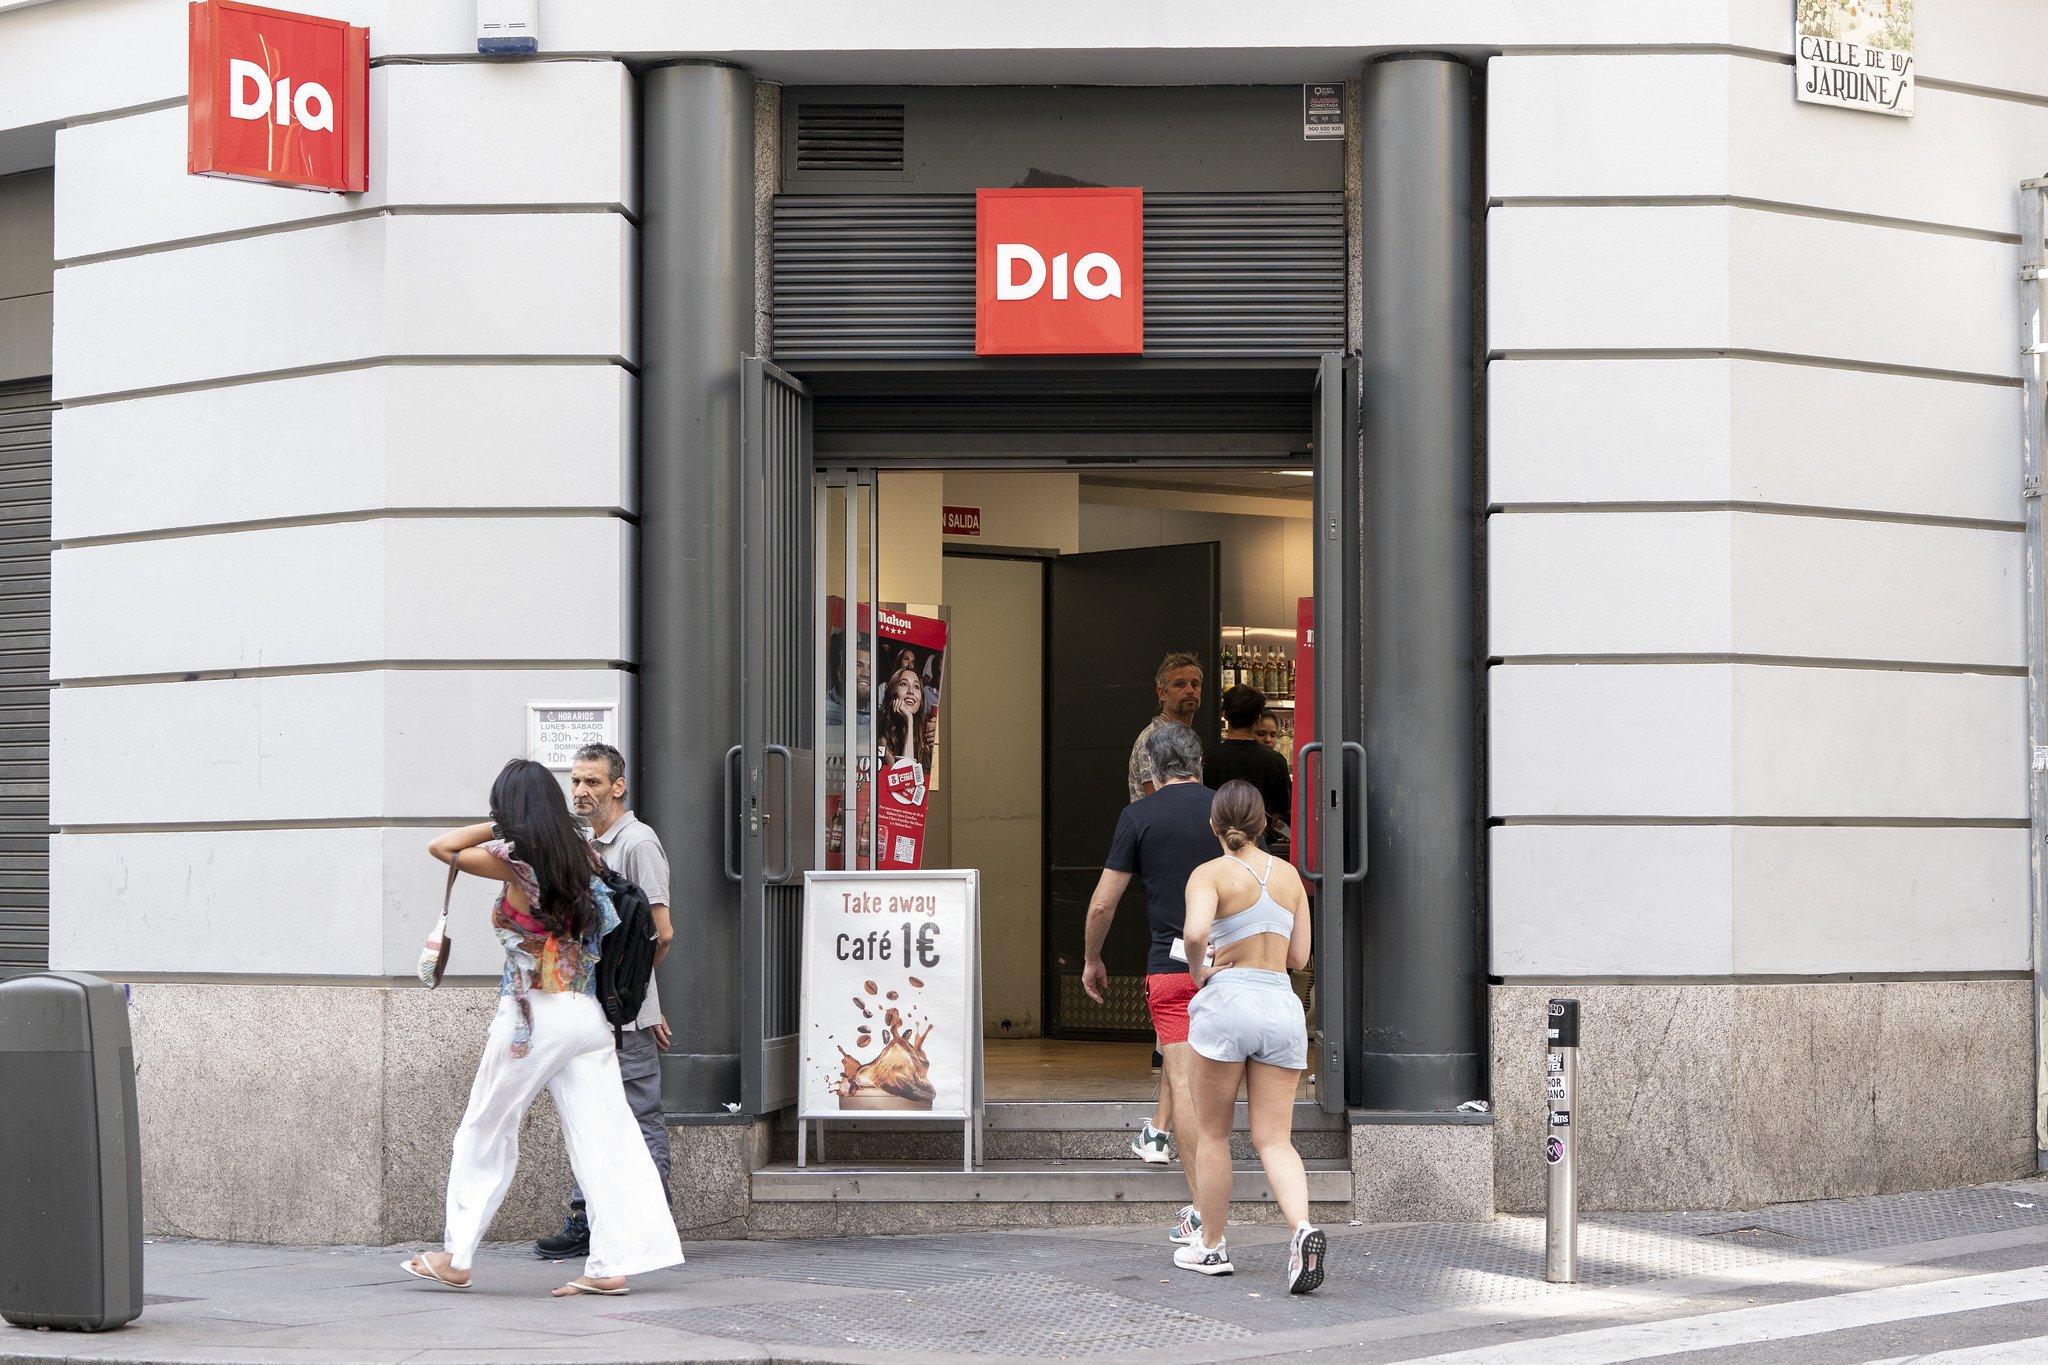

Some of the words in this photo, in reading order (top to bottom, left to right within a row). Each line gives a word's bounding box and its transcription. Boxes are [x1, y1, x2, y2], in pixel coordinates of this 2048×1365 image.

[1800, 36, 1860, 68] CALLE
[1865, 49, 1885, 69] DE
[1806, 65, 1907, 109] JARDINES
[948, 513, 979, 529] SALIDA
[878, 611, 912, 630] Mahou
[558, 712, 594, 721] HORARIOS
[540, 732, 571, 742] 8:30h
[582, 732, 603, 742] 22h
[547, 752, 567, 762] 10h
[842, 892, 881, 914] Take
[889, 895, 936, 917] away
[836, 929, 891, 961] Café
[901, 922, 941, 968] 1€
